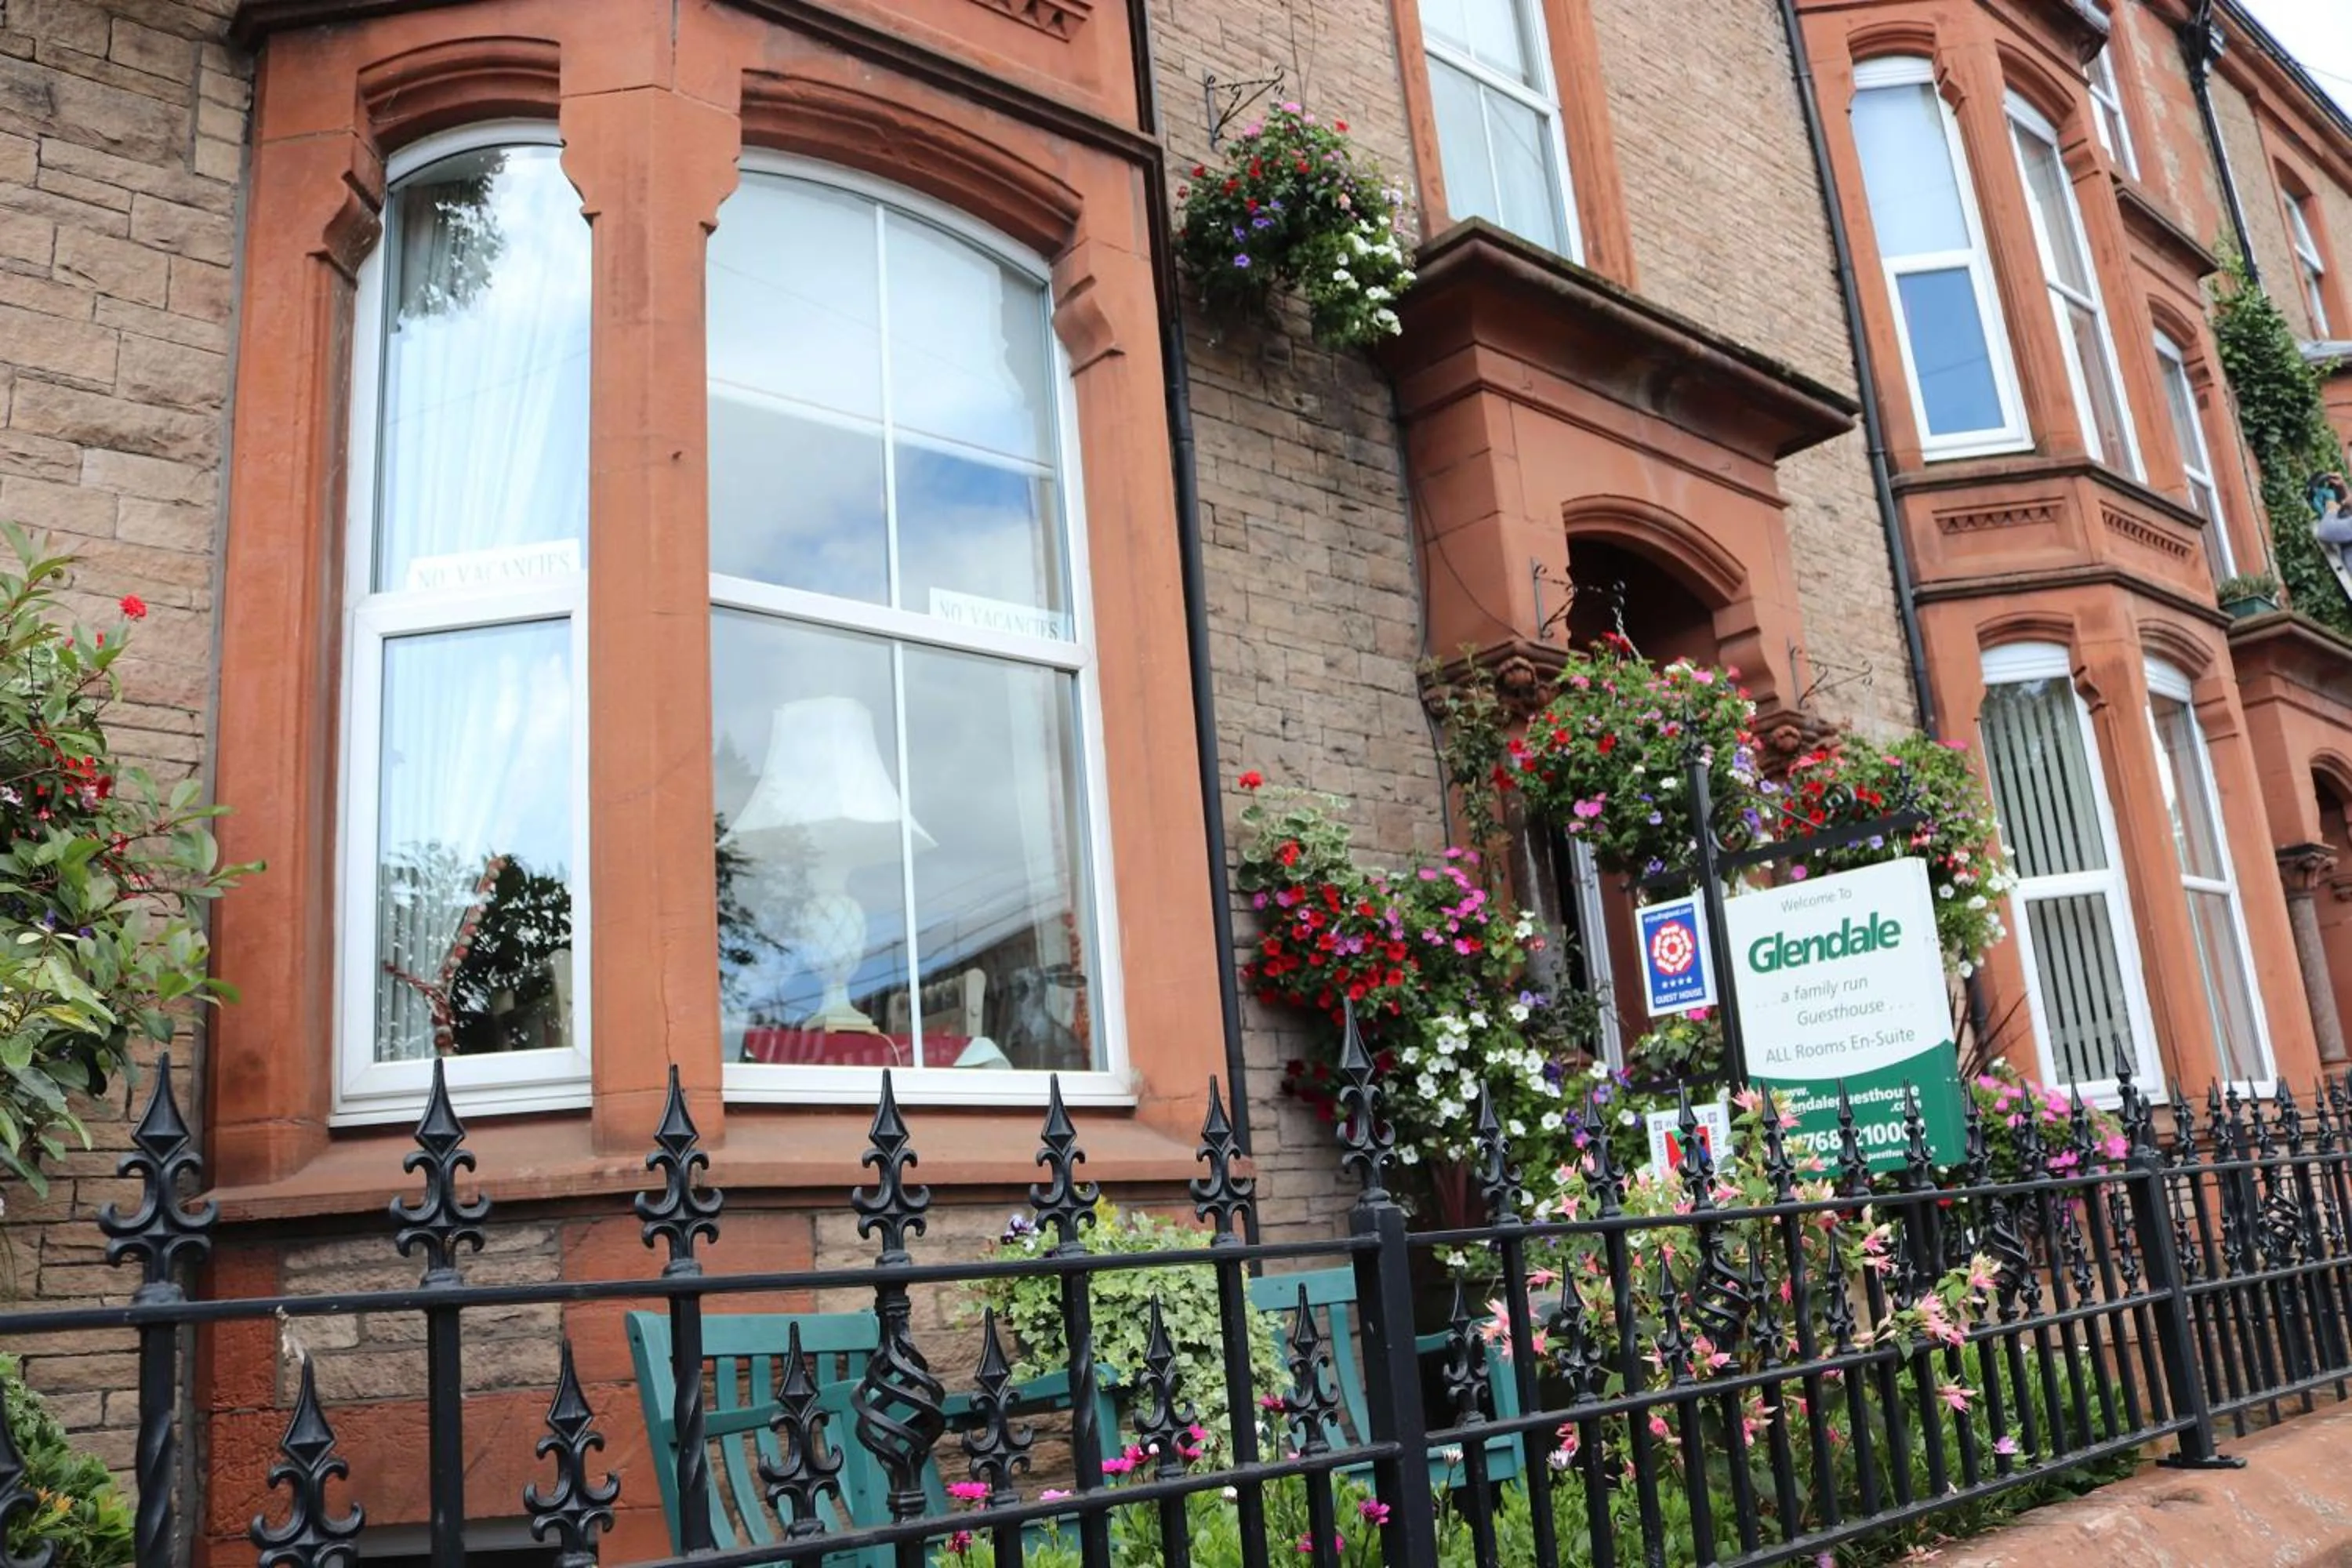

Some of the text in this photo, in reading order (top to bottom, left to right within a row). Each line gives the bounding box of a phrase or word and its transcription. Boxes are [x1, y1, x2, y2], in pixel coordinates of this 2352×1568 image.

[1780, 887, 1852, 913] Welcome To
[1748, 912, 1901, 974] Glendale
[1655, 987, 1704, 1004] GUEST HOUSE
[1780, 992, 1789, 1003] a
[1794, 980, 1838, 1001] family
[1843, 977, 1868, 992] run
[1797, 1000, 1884, 1026] Guesthouse
[1766, 1029, 1915, 1064] ALL Rooms En-Suite
[1784, 1084, 1920, 1113] endaleuesthoue
[1790, 1119, 1927, 1154] 768 2100
